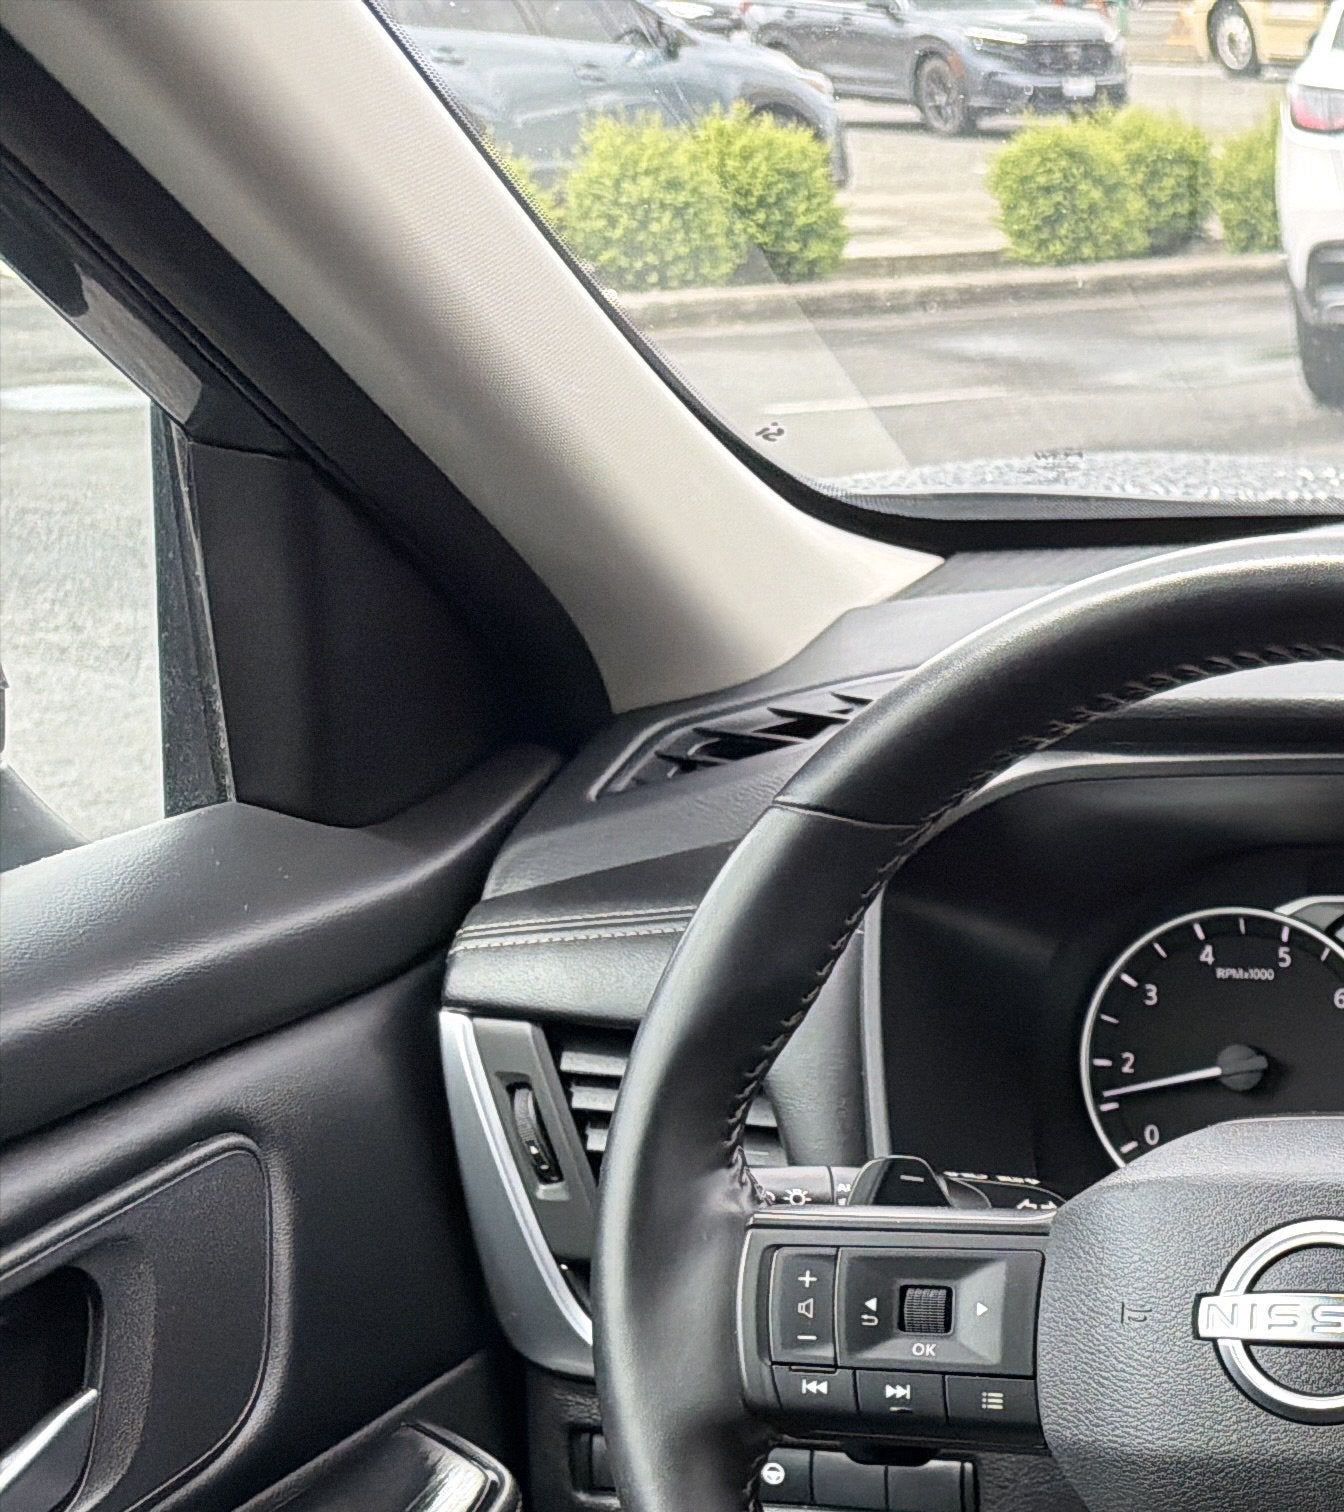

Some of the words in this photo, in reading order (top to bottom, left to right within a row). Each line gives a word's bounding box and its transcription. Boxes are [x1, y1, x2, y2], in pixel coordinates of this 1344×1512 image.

[1199, 944, 1215, 965] 4
[1277, 946, 1292, 968] 5
[1144, 984, 1158, 1006] 3
[1120, 1052, 1135, 1073] 2
[1144, 1124, 1160, 1145] 0
[911, 1343, 937, 1357] OK
